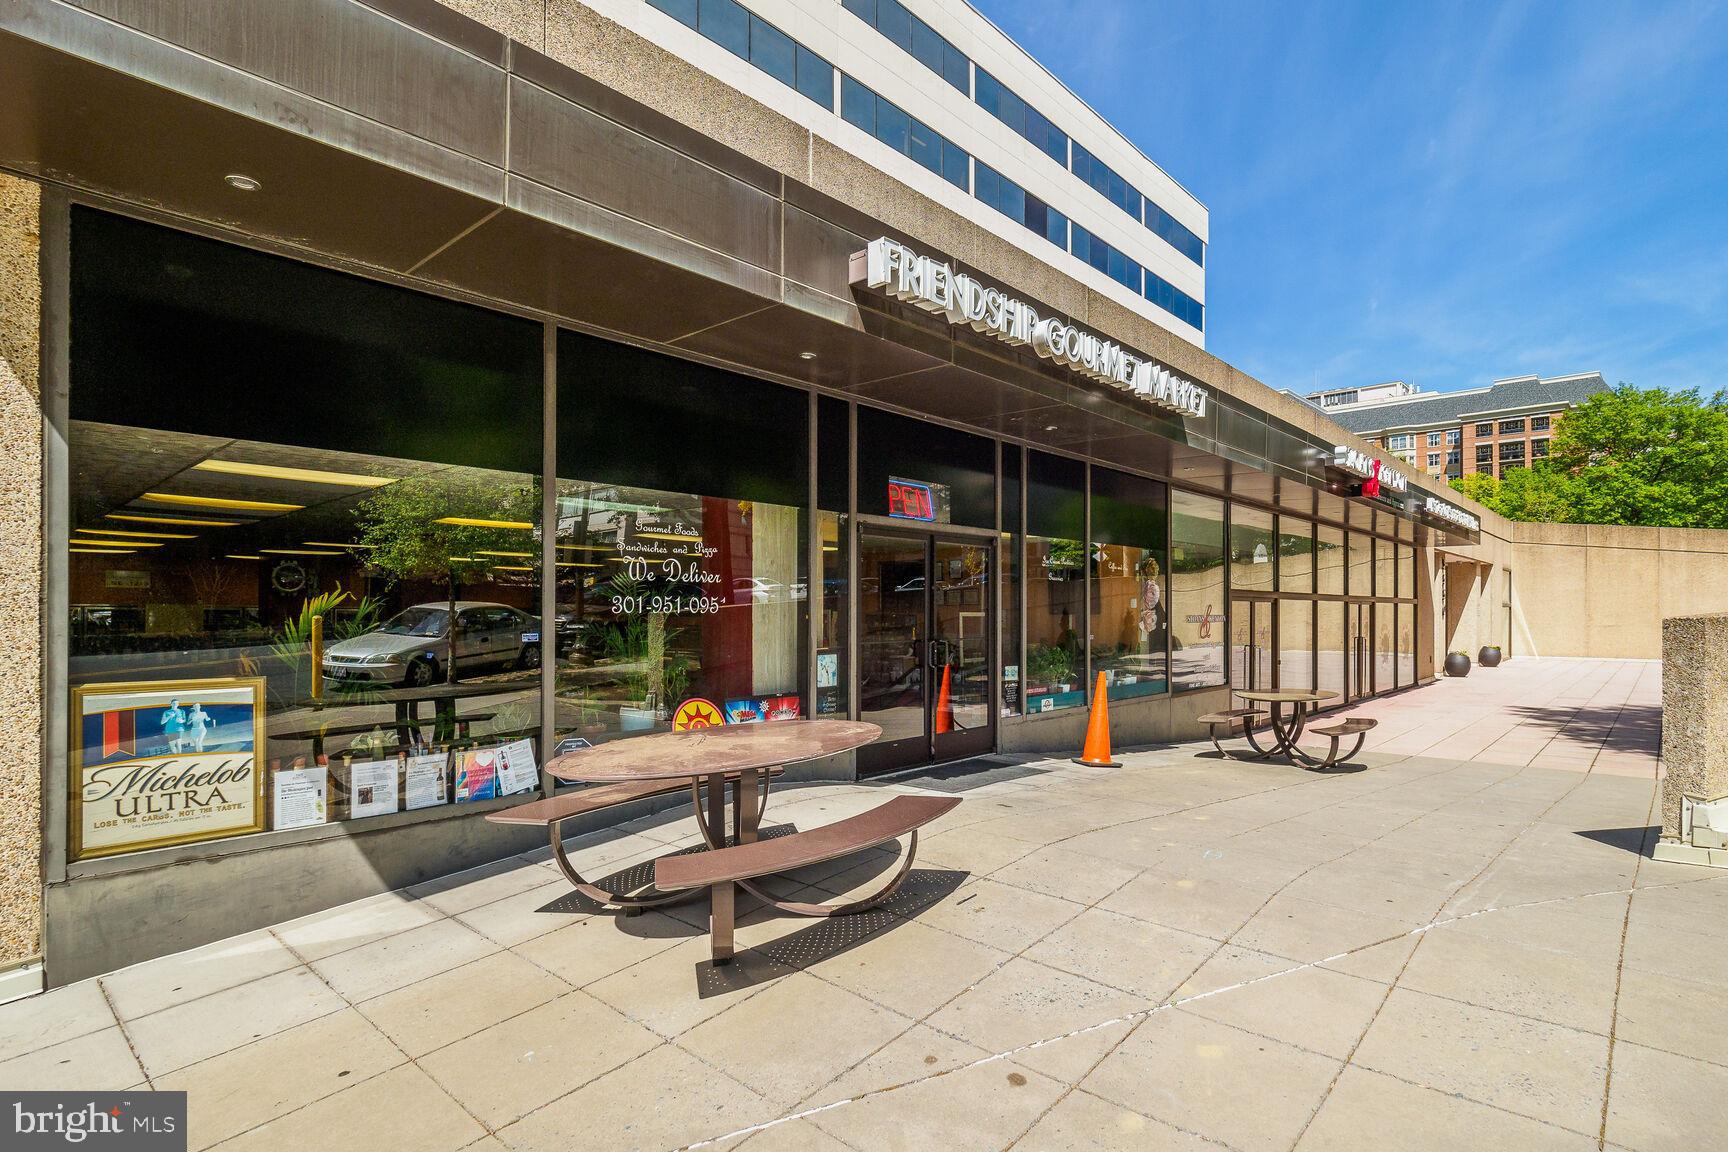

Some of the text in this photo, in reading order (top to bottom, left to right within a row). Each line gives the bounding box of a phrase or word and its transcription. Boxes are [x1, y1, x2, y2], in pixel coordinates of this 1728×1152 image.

[868, 236, 1208, 418] FRIENDSHIP GOURMET MARKET
[888, 484, 931, 519] PEN
[635, 519, 699, 537] Gourmet Foods
[617, 537, 668, 556] Sandwiches
[694, 541, 718, 558] Pizza
[623, 555, 722, 583] We Deliver
[83, 760, 254, 803] Michelob
[93, 819, 118, 829] LOSE
[178, 809, 196, 818] NOT
[200, 806, 213, 814] THE
[216, 802, 246, 812] TASTE.
[115, 786, 229, 818] ULTRA
